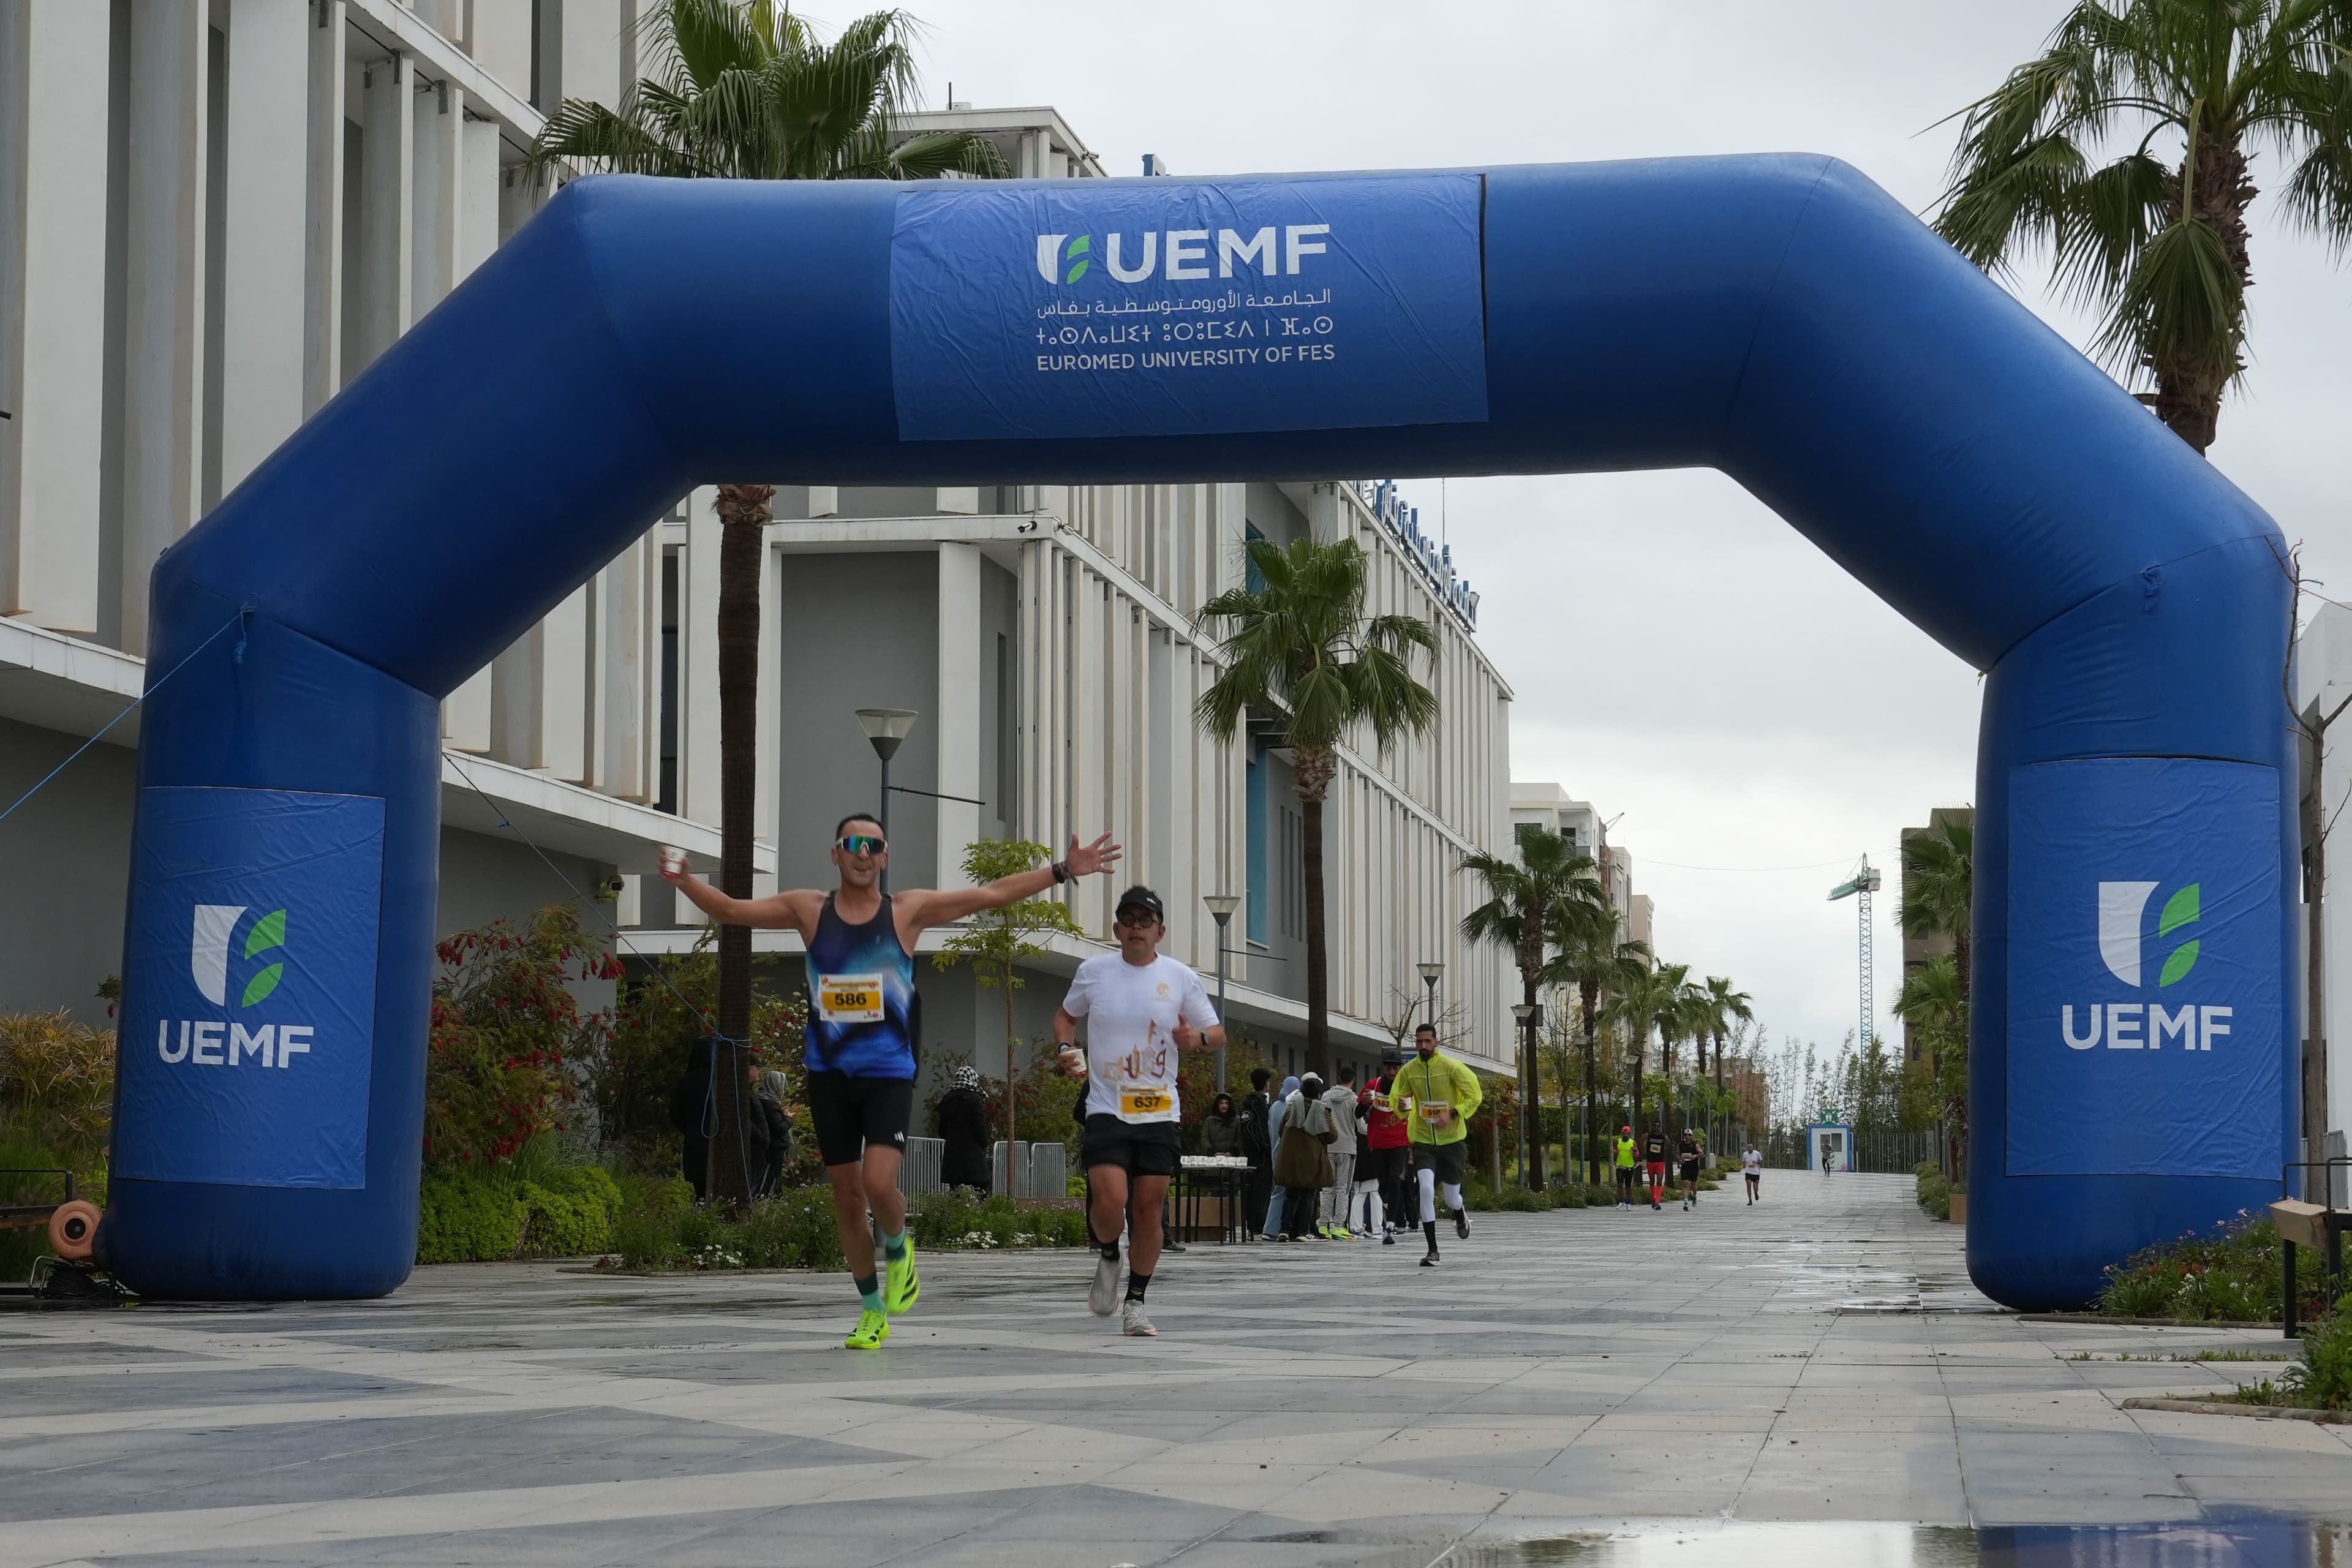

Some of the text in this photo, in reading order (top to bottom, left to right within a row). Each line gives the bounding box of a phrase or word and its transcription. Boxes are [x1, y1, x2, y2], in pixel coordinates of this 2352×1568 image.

[1107, 224, 1330, 283] UEMF
[1038, 288, 1330, 318] الجامعة الأورومتوسطية بفاس
[1038, 344, 1335, 371] EUROMED UNIVERSITY OF FES
[835, 992, 867, 1006] 586
[2062, 1003, 2233, 1051] UEMF
[158, 1019, 314, 1068] UEMF
[1134, 1096, 1161, 1108] 637
